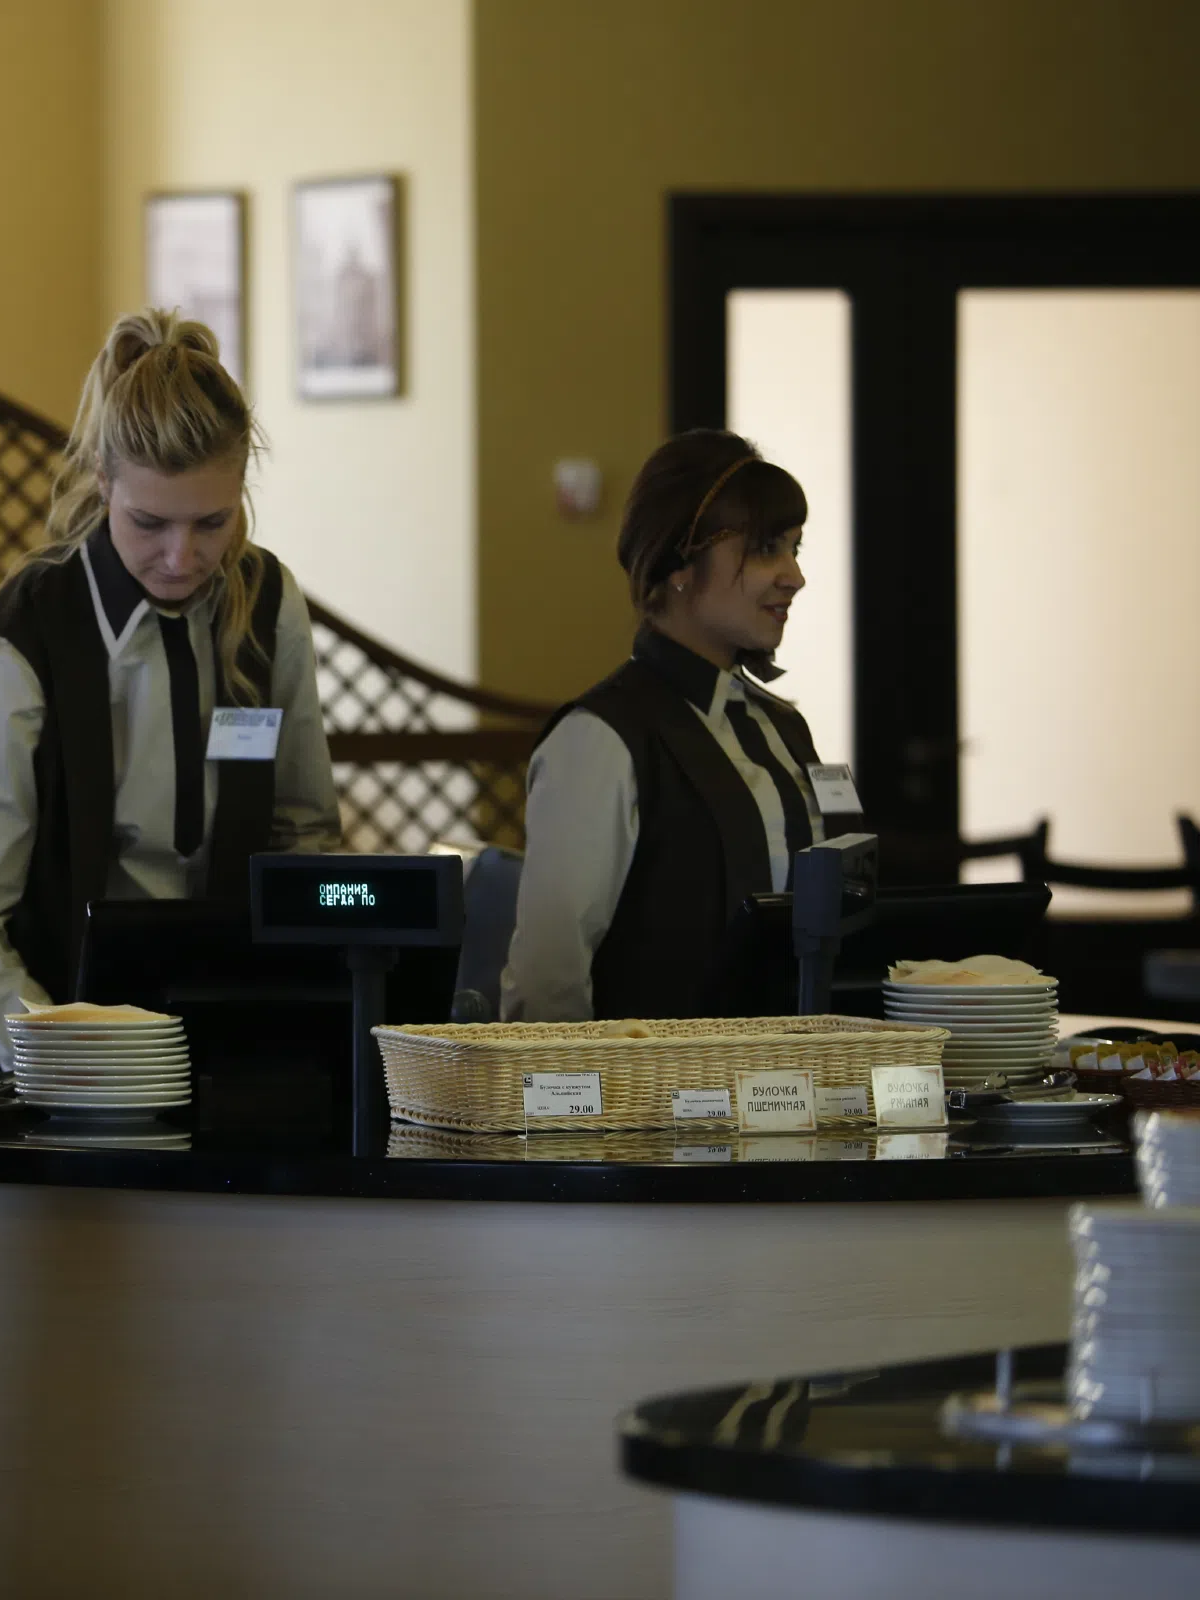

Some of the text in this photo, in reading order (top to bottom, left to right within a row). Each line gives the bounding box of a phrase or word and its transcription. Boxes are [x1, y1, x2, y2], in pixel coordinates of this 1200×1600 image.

[319, 883, 368, 895] ОМПАНИЯ
[319, 894, 376, 906] СЕГДА ПО
[752, 1085, 798, 1097] БУЛОЧКА
[887, 1082, 930, 1093] БУЛОЧКА
[569, 1104, 594, 1114] 29.00
[747, 1100, 806, 1113] ПШЕНИЧНАЯ
[891, 1097, 929, 1109] РЖАНАЯ
[707, 1110, 726, 1118] 29.00
[843, 1107, 863, 1117] 29.00
